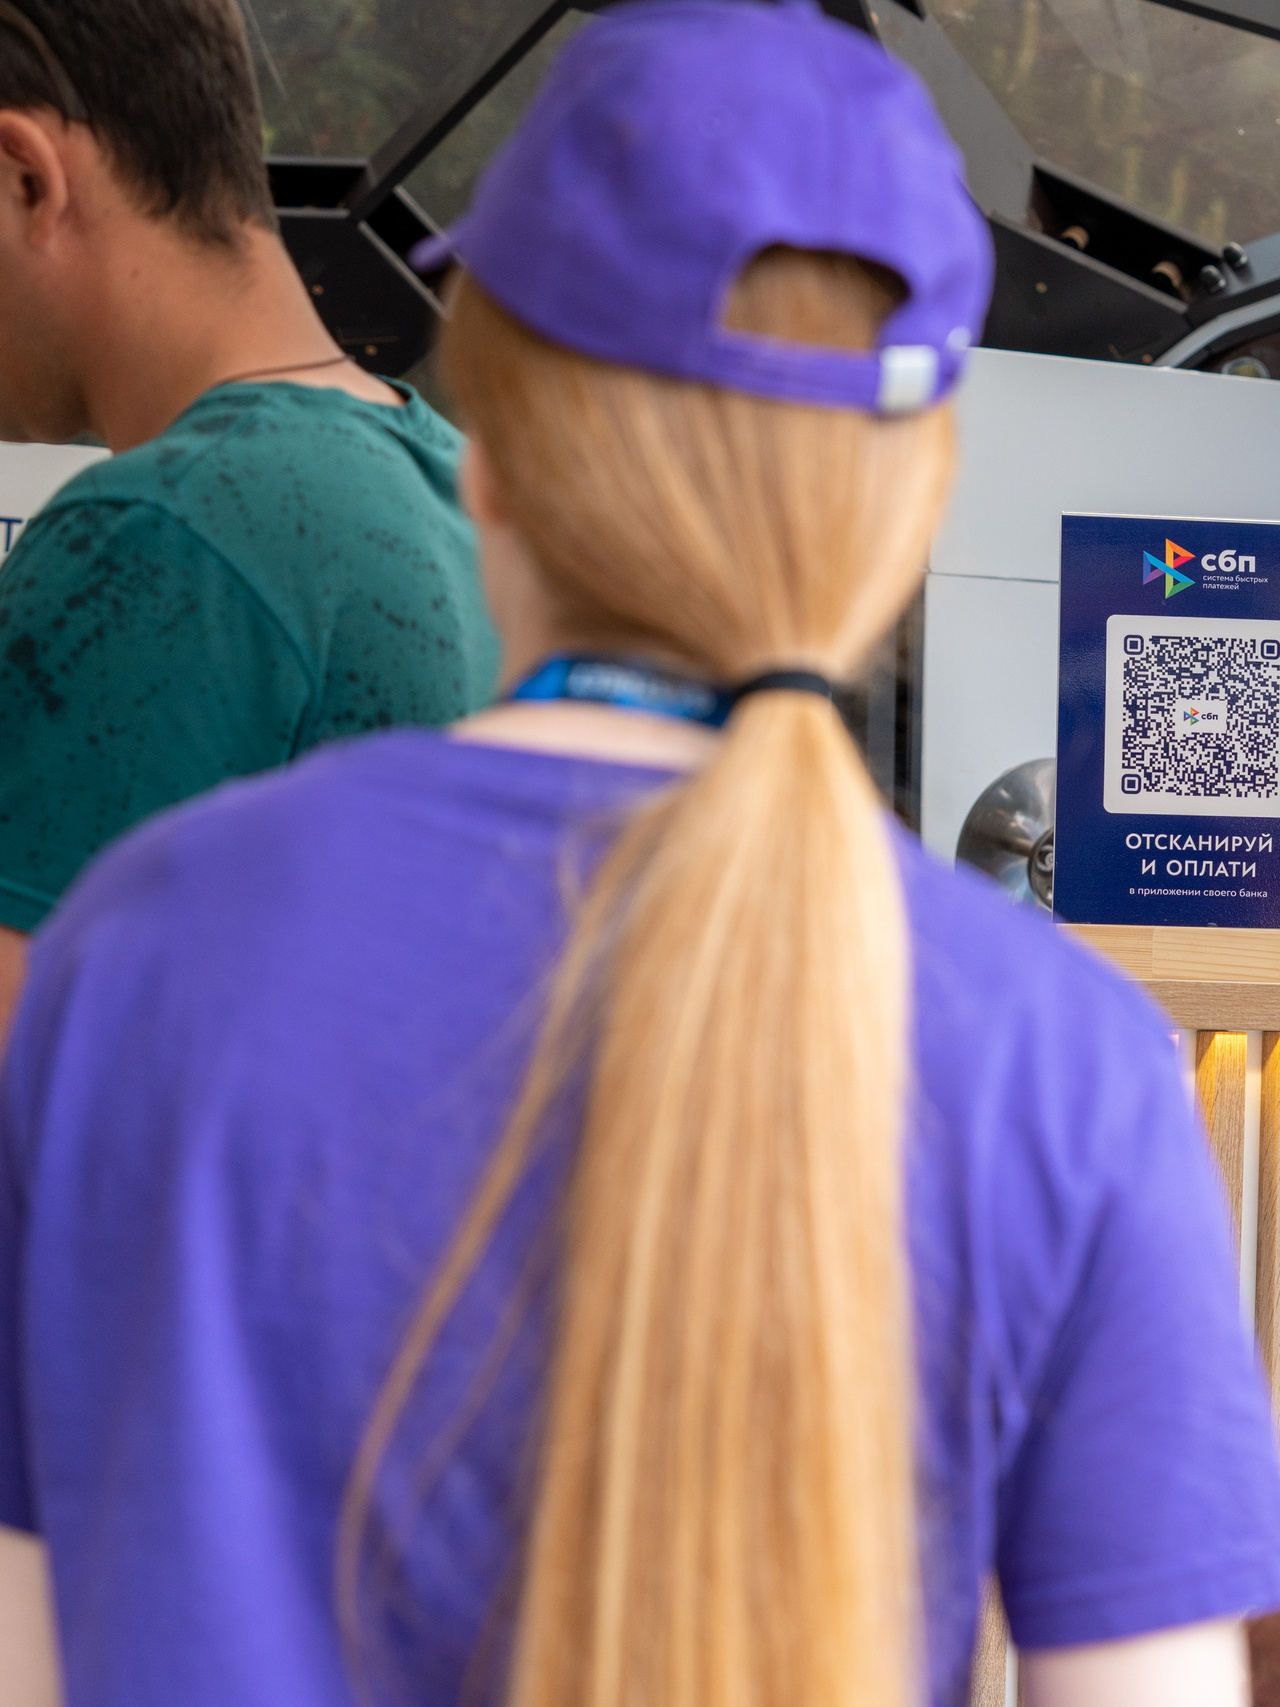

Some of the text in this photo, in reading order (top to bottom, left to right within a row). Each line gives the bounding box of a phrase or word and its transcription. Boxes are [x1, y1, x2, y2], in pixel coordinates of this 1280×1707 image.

[1201, 549, 1256, 573] сбп
[1235, 575, 1269, 584] быстрых
[1201, 712, 1219, 721] сбп
[1125, 833, 1273, 853] ОТСКАНИРУЙ
[1141, 859, 1257, 878] И ОПЛАТИ
[1137, 888, 1201, 897] приложении
[1203, 889, 1237, 897] своего
[1239, 888, 1268, 898] банка
